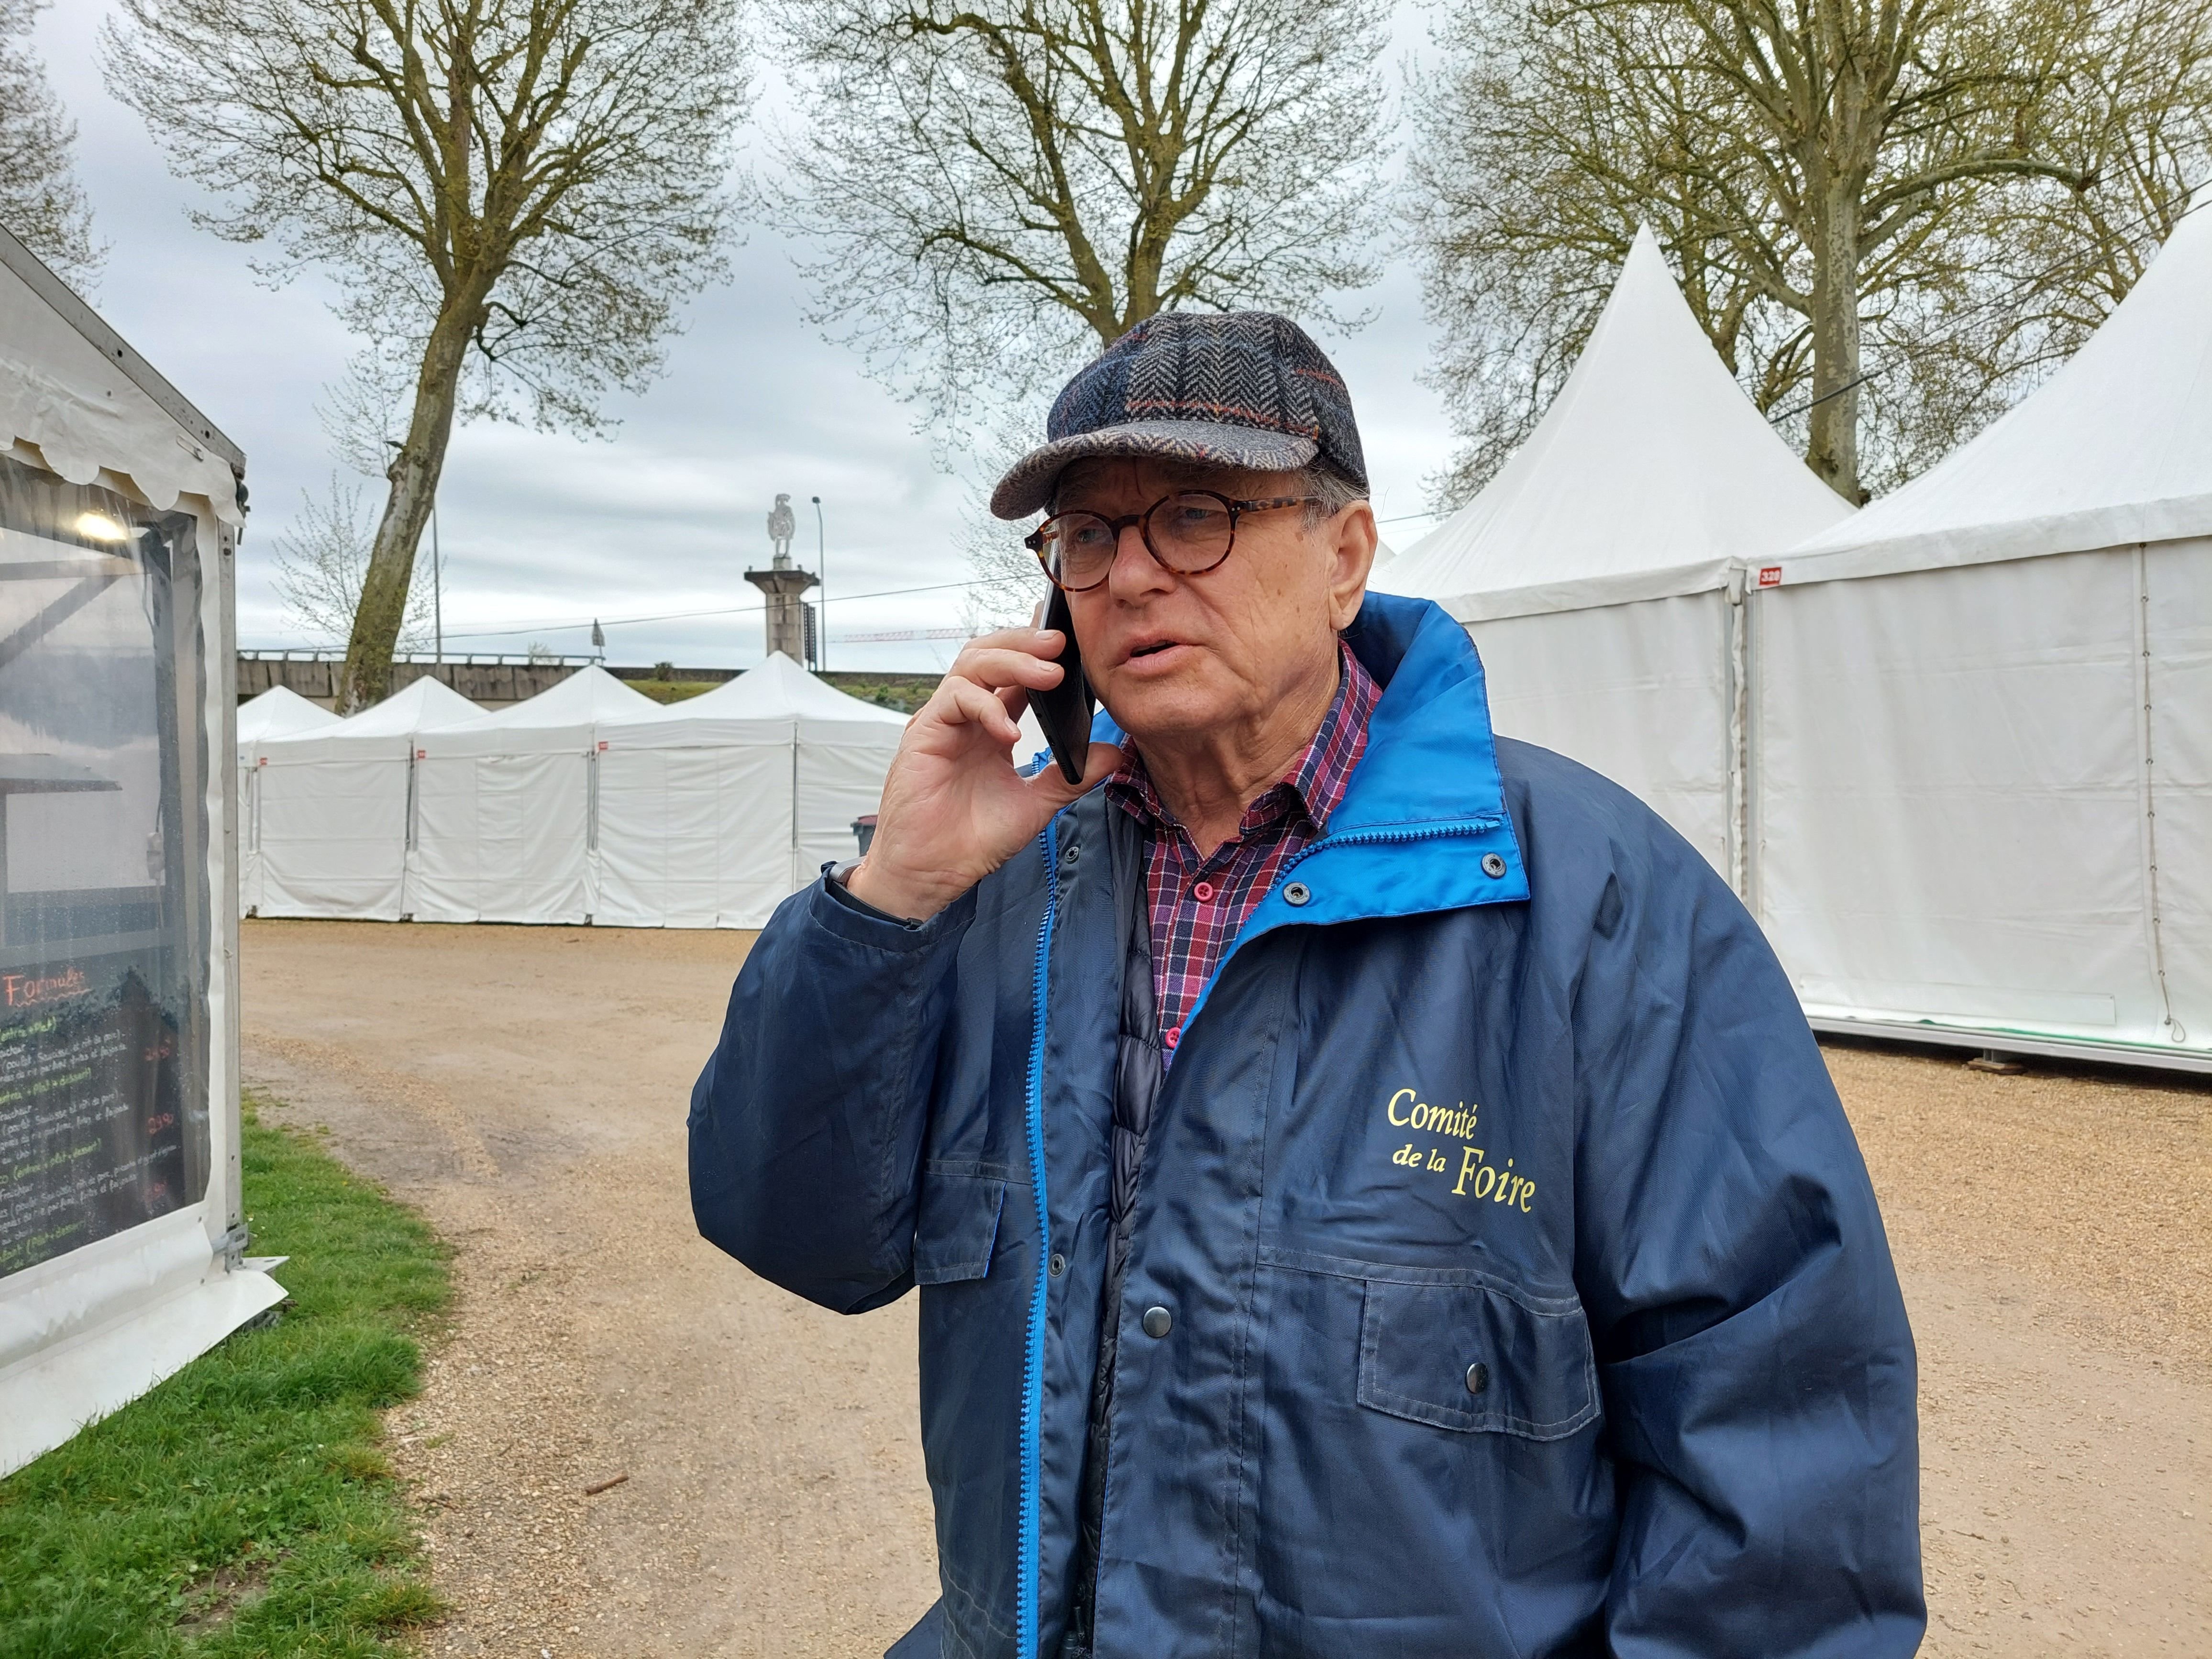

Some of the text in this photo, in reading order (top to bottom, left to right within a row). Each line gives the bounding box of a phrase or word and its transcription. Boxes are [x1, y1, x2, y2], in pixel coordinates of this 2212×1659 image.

[1388, 1088, 1478, 1140] Comité
[1393, 1144, 1536, 1213] de la Foire
